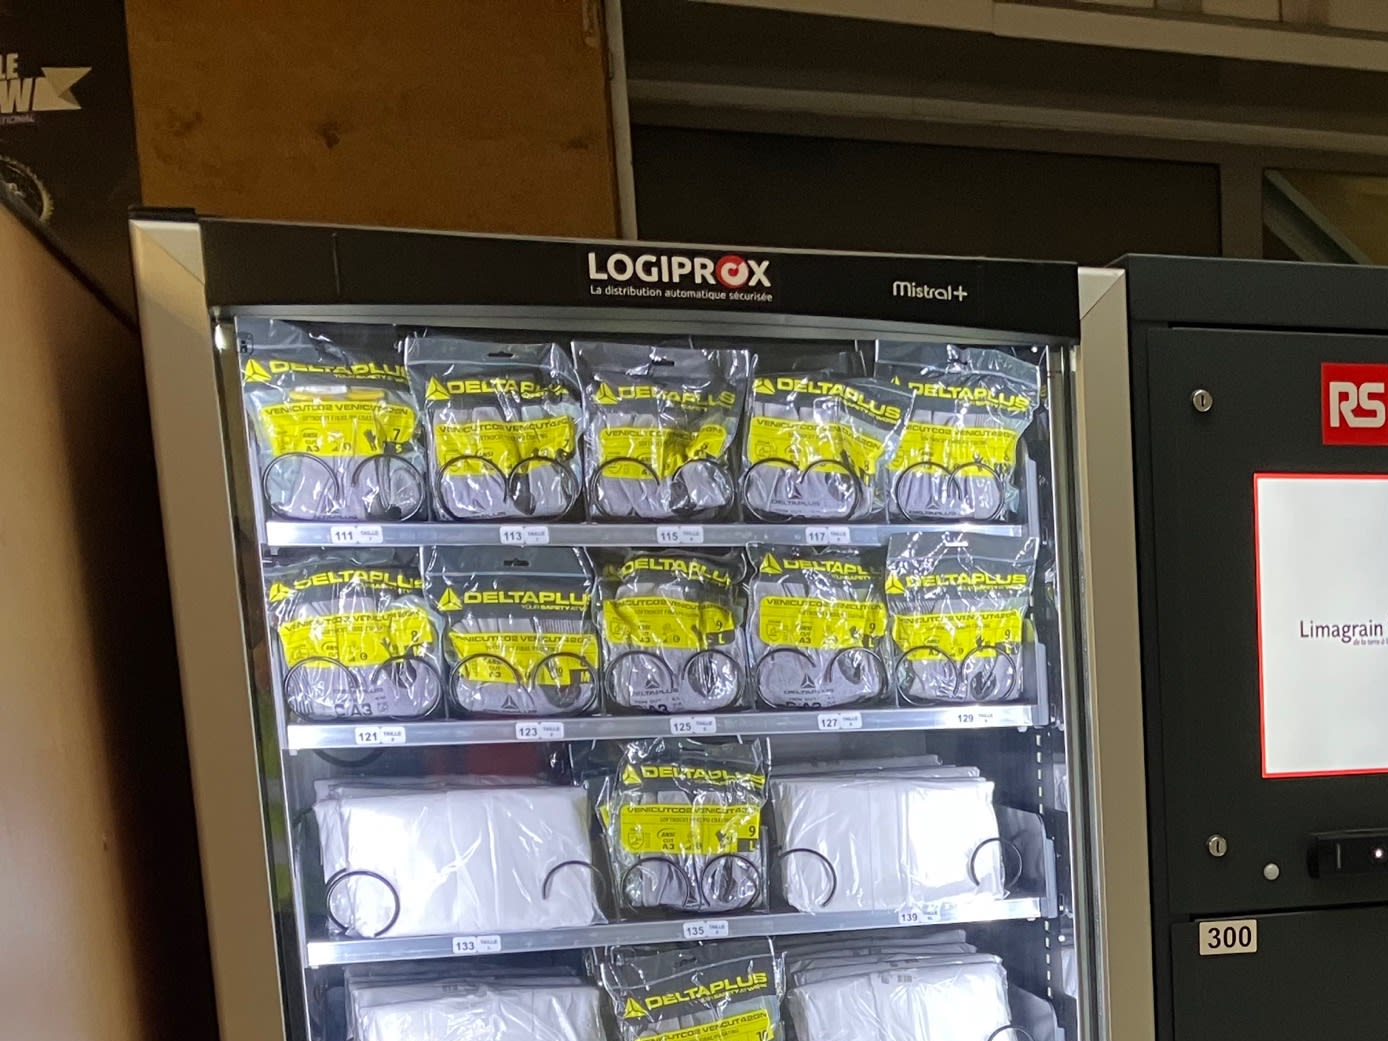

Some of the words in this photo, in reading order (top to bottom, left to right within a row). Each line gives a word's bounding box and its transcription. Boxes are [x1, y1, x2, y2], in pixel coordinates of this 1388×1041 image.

[587, 252, 771, 288] LOGIPROX
[590, 285, 602, 295] La
[604, 286, 662, 298] distribution
[664, 288, 726, 301] automatique
[728, 290, 773, 302] sécurisée
[892, 281, 968, 301] Mistral+
[777, 378, 901, 419] DELTAPLUS
[908, 382, 1031, 411] DELTAPLUS
[1329, 381, 1386, 428] RS
[335, 531, 353, 541] 111
[504, 531, 522, 541] 113
[660, 532, 678, 541] 115
[809, 532, 825, 541] 117
[906, 574, 1027, 588] DELTAPLUS
[869, 622, 876, 633] 9
[1299, 619, 1383, 644] Limagrain
[822, 718, 838, 728] 127
[958, 714, 974, 723] 129
[519, 727, 537, 737] 123
[673, 722, 692, 732] 125
[359, 732, 377, 742] 121
[748, 825, 756, 837] 9
[901, 913, 918, 922] 139
[686, 926, 704, 936] 135
[1207, 925, 1252, 950] 300
[456, 942, 474, 951] 133
[644, 972, 768, 1010] DELTAPLUS
